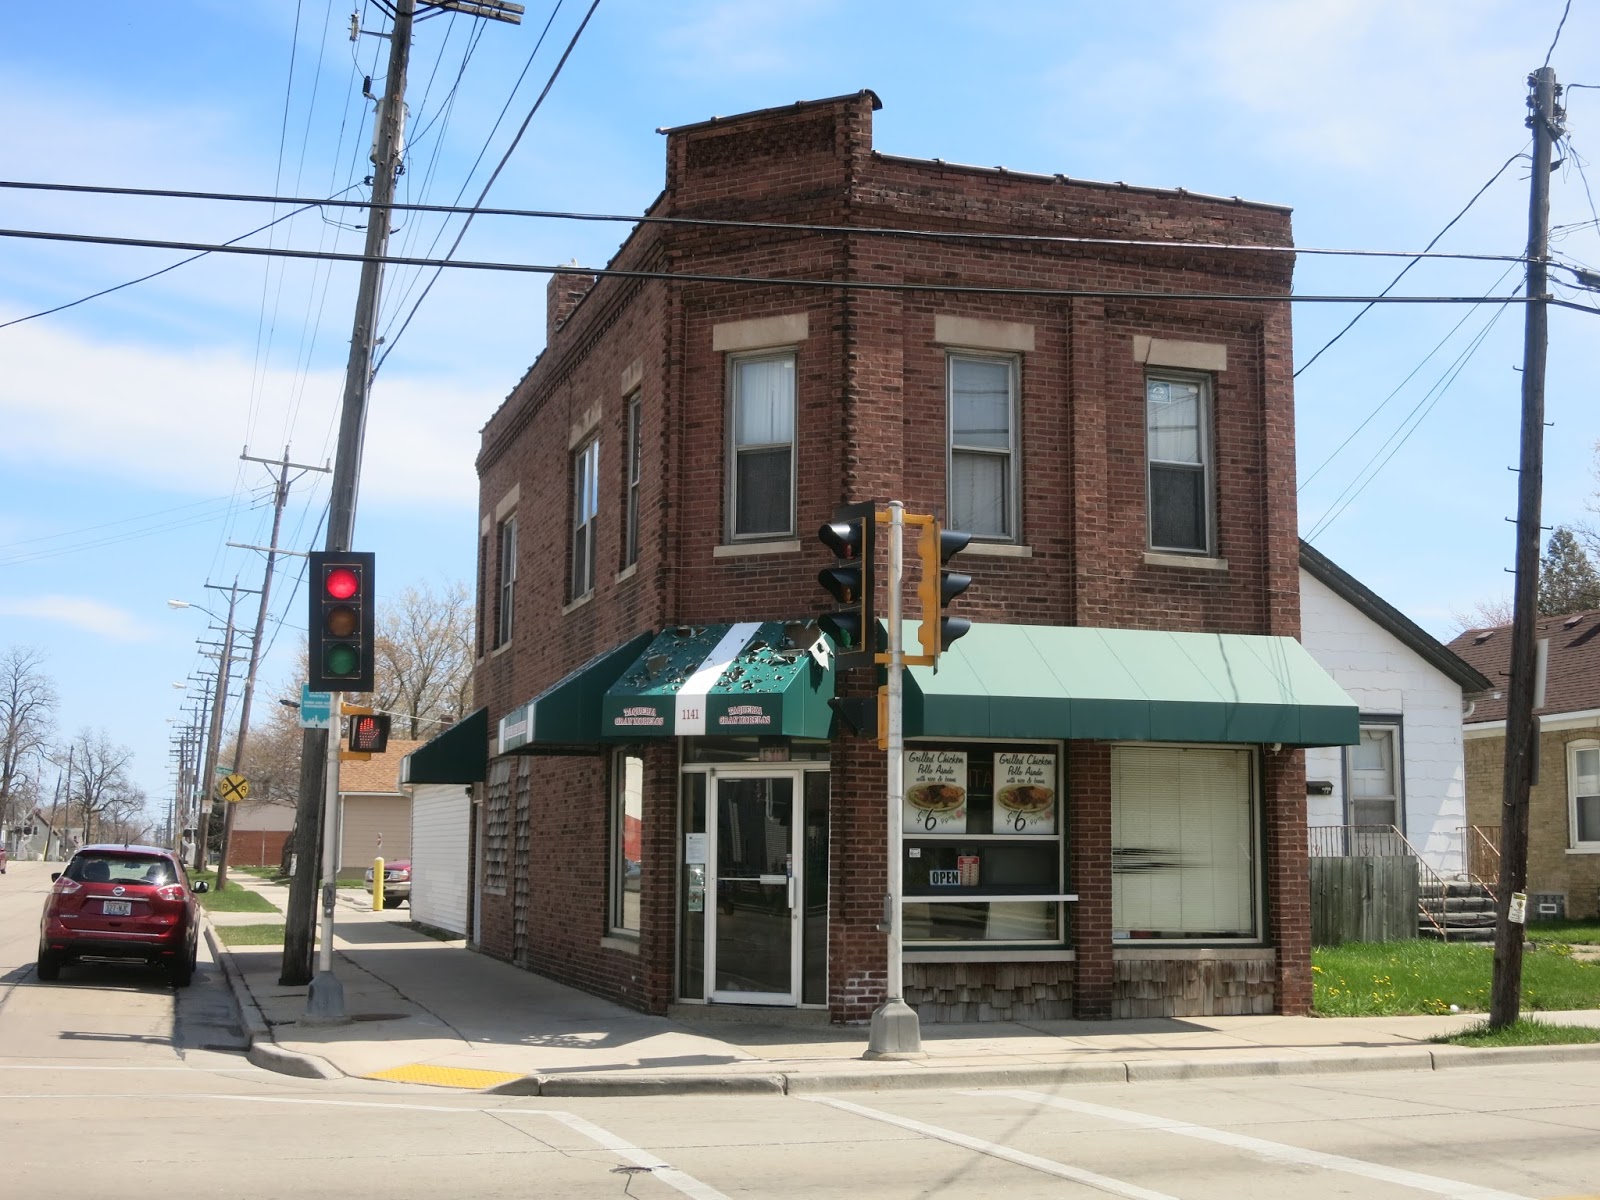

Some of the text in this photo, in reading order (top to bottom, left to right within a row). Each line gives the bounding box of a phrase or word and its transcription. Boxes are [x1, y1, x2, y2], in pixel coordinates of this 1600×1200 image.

[624, 707, 657, 716] TAQUERIA
[682, 709, 699, 720] 1141
[728, 705, 763, 715] TAQUERIA
[615, 717, 664, 726] GRAN MORELOS
[719, 716, 771, 724] GRAN MORELOS
[908, 751, 964, 764] Grilled Chicken
[999, 753, 1053, 765] Grilled Chicken
[917, 763, 954, 775] Pollo Asado
[1008, 765, 1043, 776] Pollo Asado
[222, 783, 228, 791] R
[932, 871, 959, 884] OPEN
